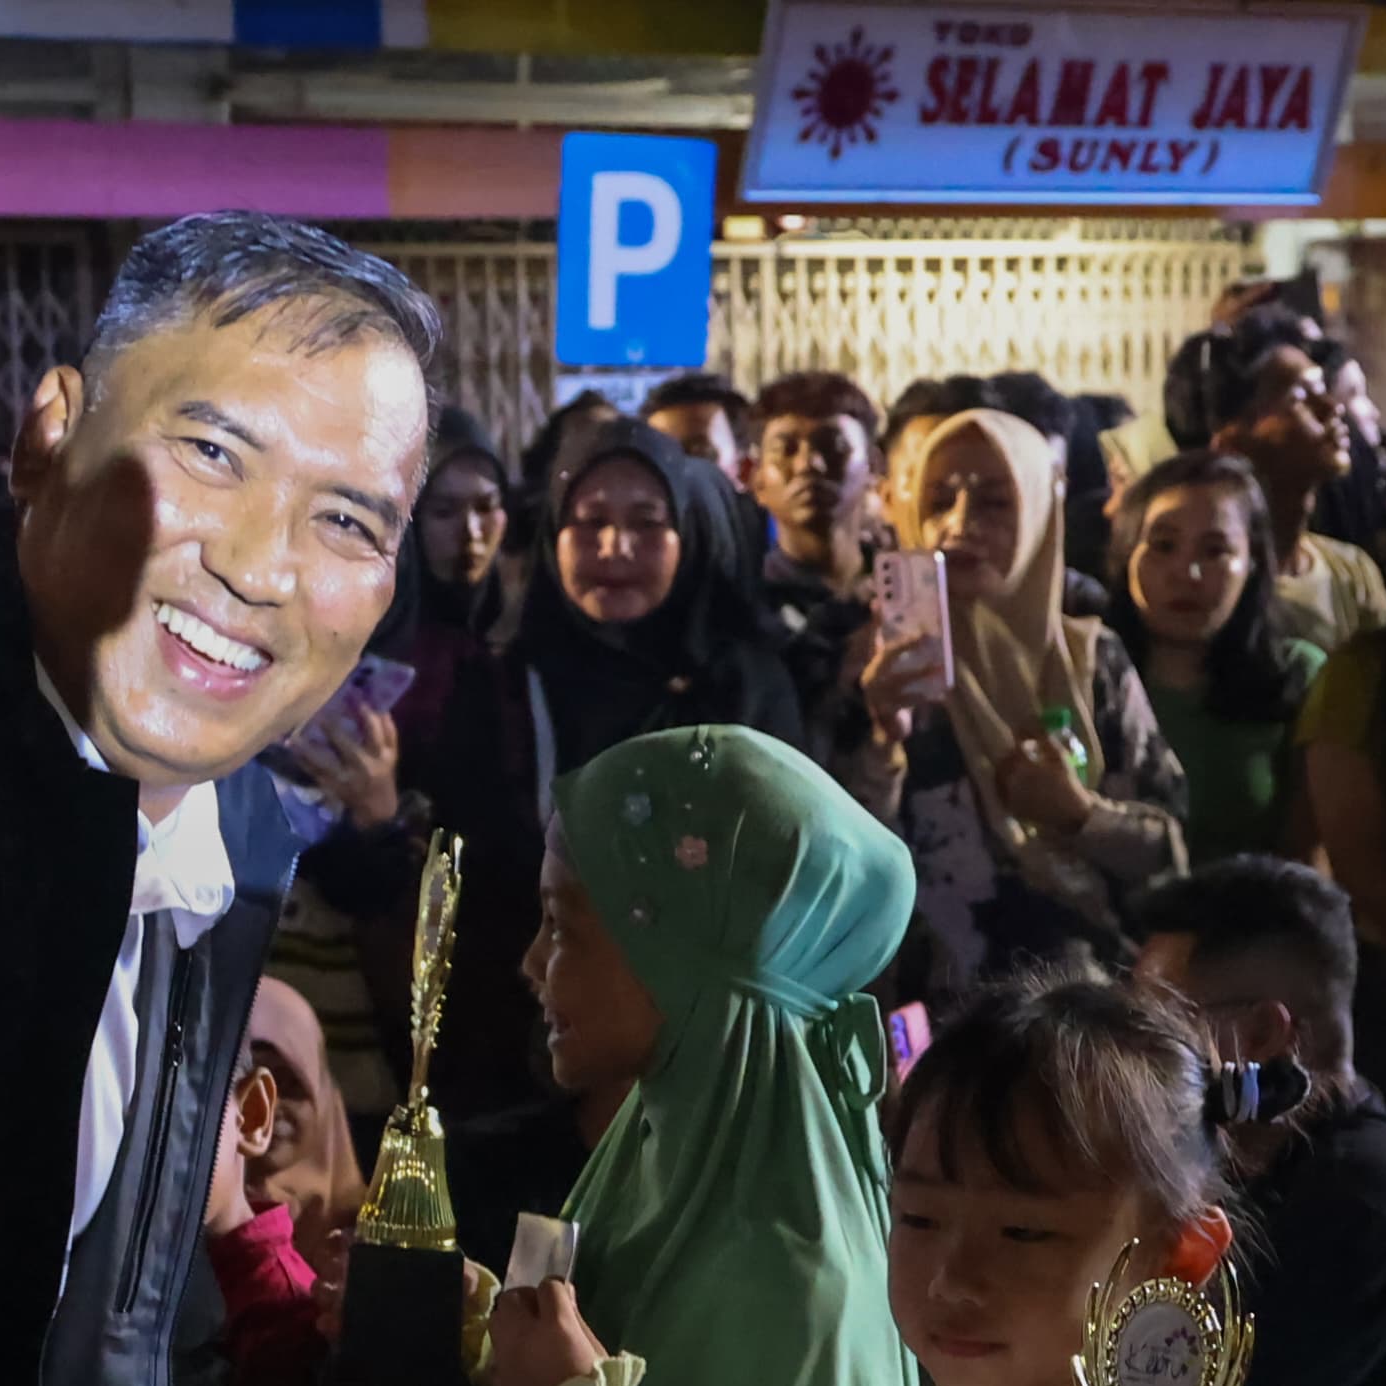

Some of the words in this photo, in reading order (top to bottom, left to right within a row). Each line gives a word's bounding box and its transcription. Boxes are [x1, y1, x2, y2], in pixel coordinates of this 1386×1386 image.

[919, 57, 1169, 128] SELAMAT
[1191, 63, 1312, 130] JAYA
[588, 170, 683, 330] P
